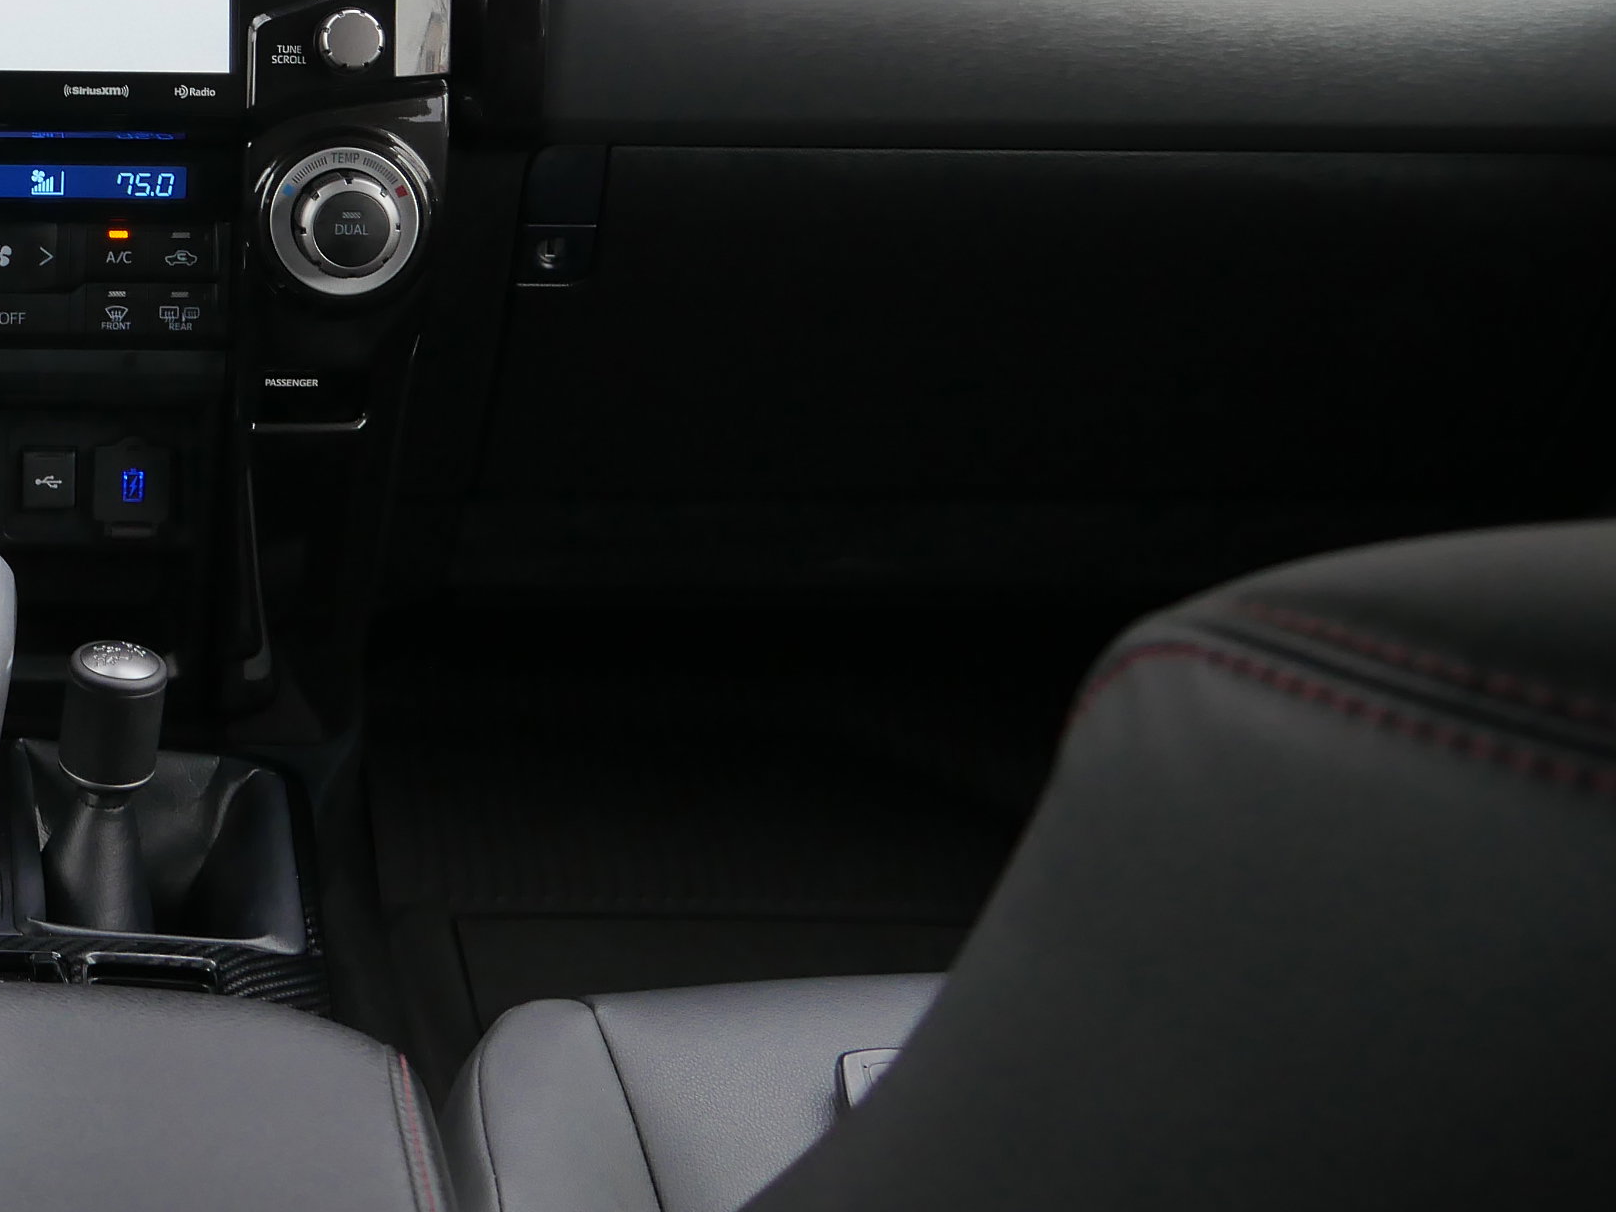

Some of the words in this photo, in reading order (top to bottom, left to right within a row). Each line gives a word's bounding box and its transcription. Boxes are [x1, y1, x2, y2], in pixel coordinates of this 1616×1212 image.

[276, 44, 302, 54] TUNE
[271, 55, 307, 64] SCROLL
[189, 87, 216, 97] Radio
[330, 152, 360, 164] TEMP
[117, 171, 175, 197] 75.0
[334, 223, 369, 236] DUAL
[105, 250, 133, 264] A/C
[100, 321, 132, 331] FRONT
[168, 322, 193, 331] REAR
[264, 378, 319, 388] PASSENGER
